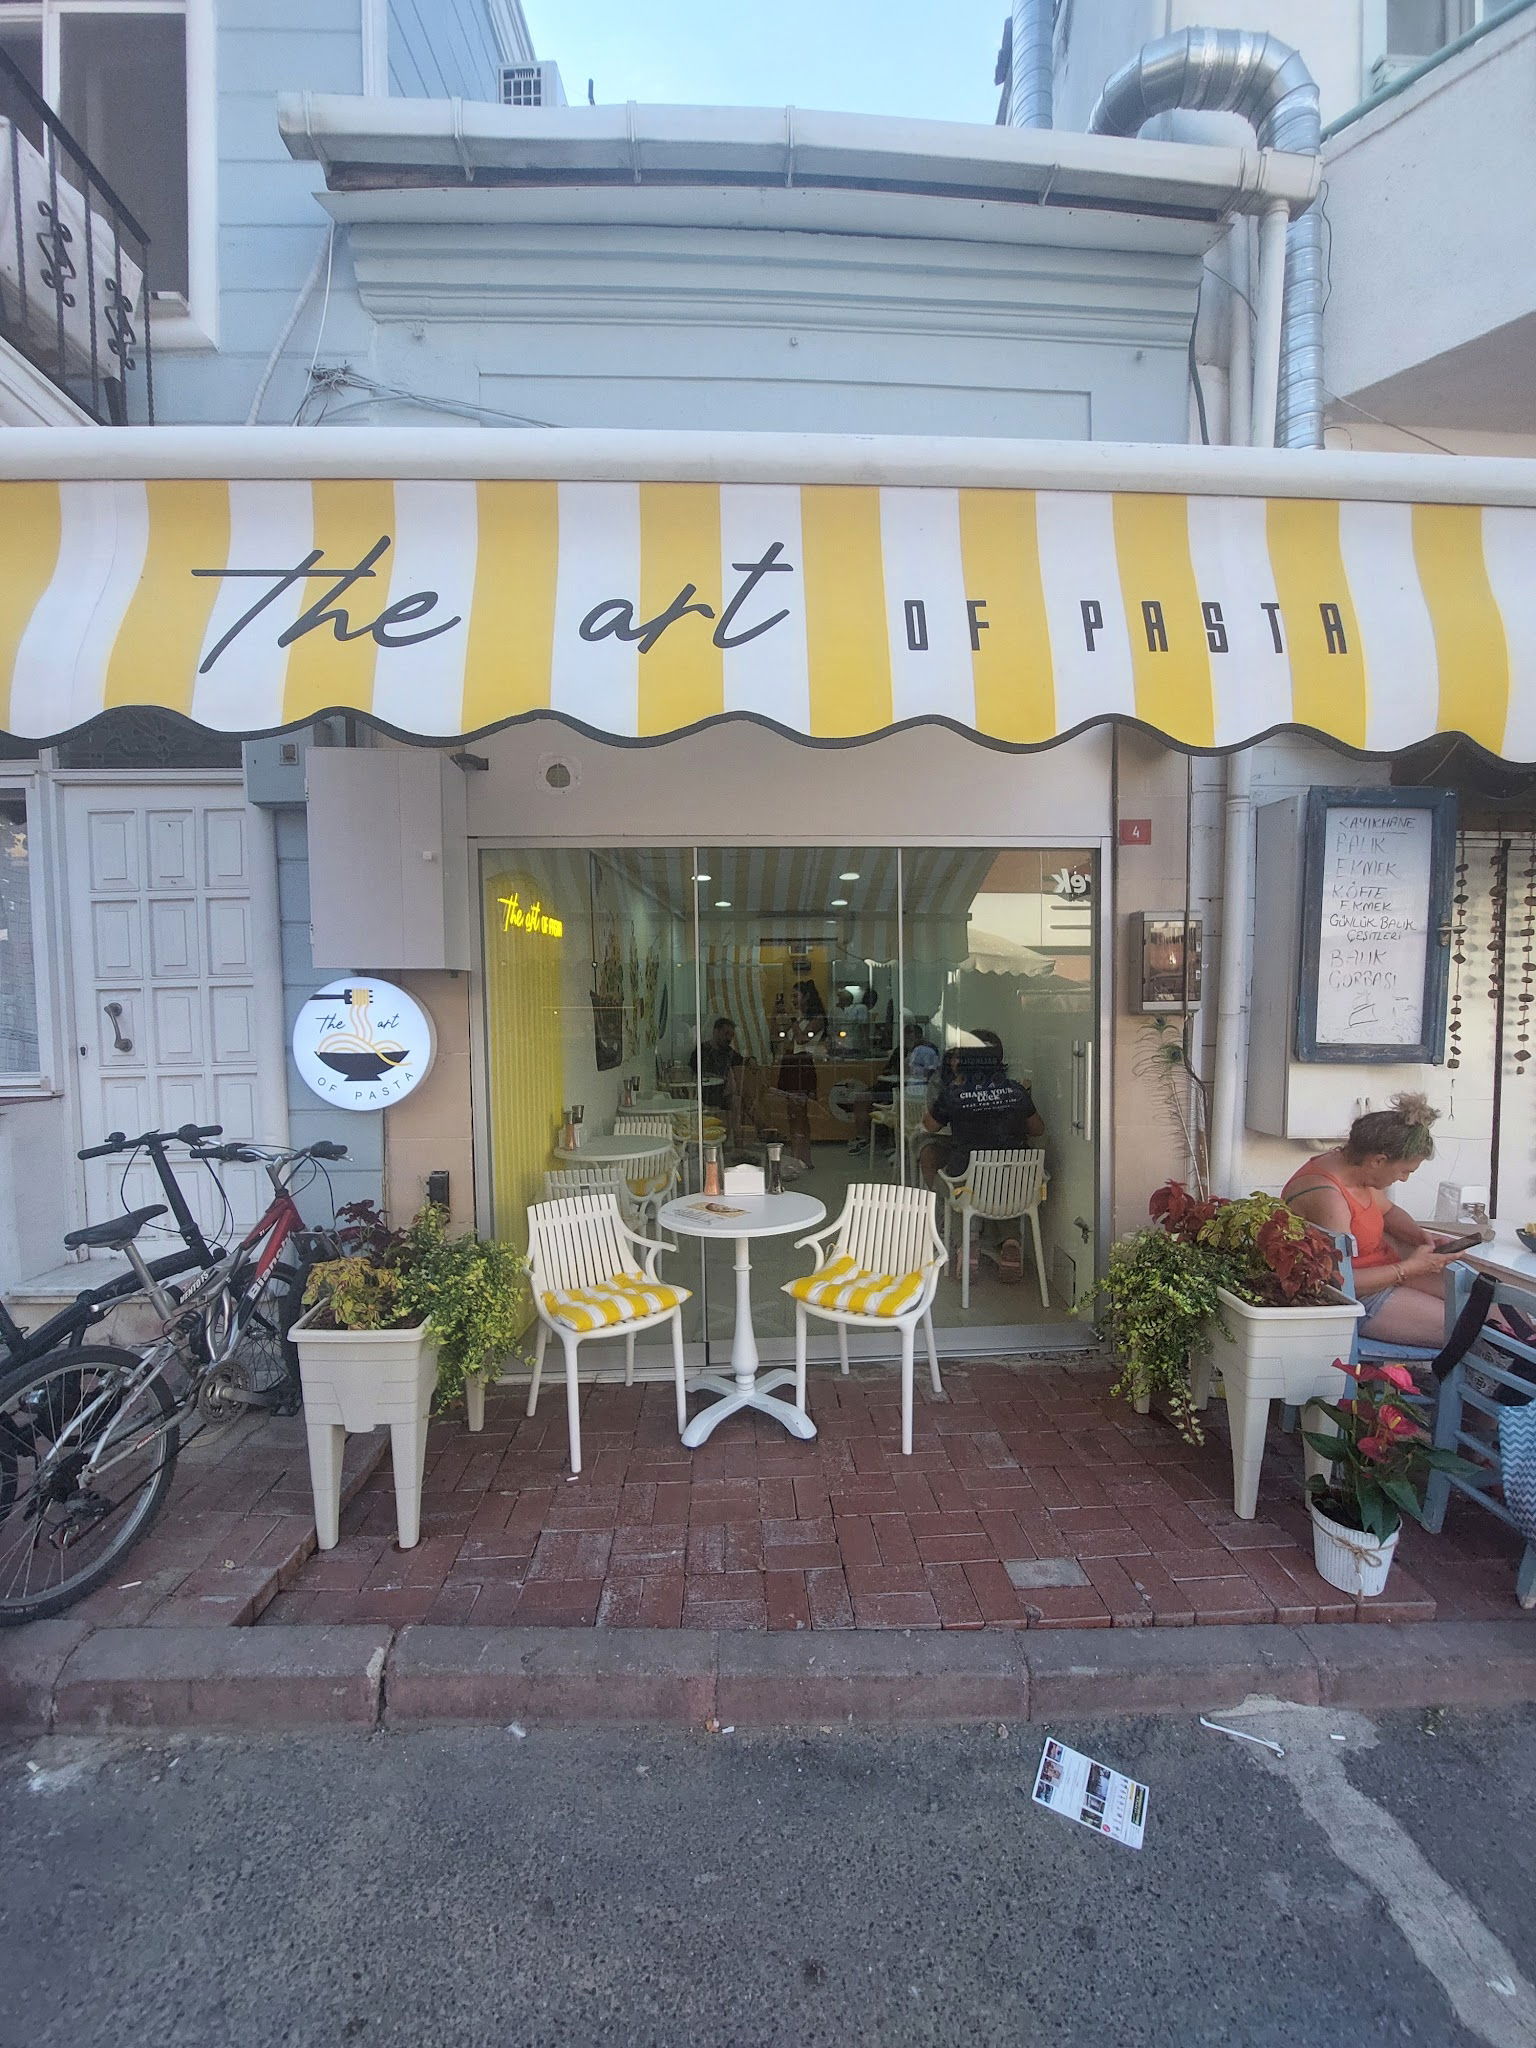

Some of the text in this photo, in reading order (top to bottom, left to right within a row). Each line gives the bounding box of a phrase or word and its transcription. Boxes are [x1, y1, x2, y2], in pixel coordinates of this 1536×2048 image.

[191, 535, 1347, 674] The art OF PASTA
[1132, 825, 1140, 838] 4
[1332, 881, 1387, 899] KÖFTE
[1340, 900, 1393, 912] EKMEK
[1380, 916, 1416, 931] BALIK
[314, 1013, 400, 1033] The art
[317, 1072, 414, 1100] OF PASTA
